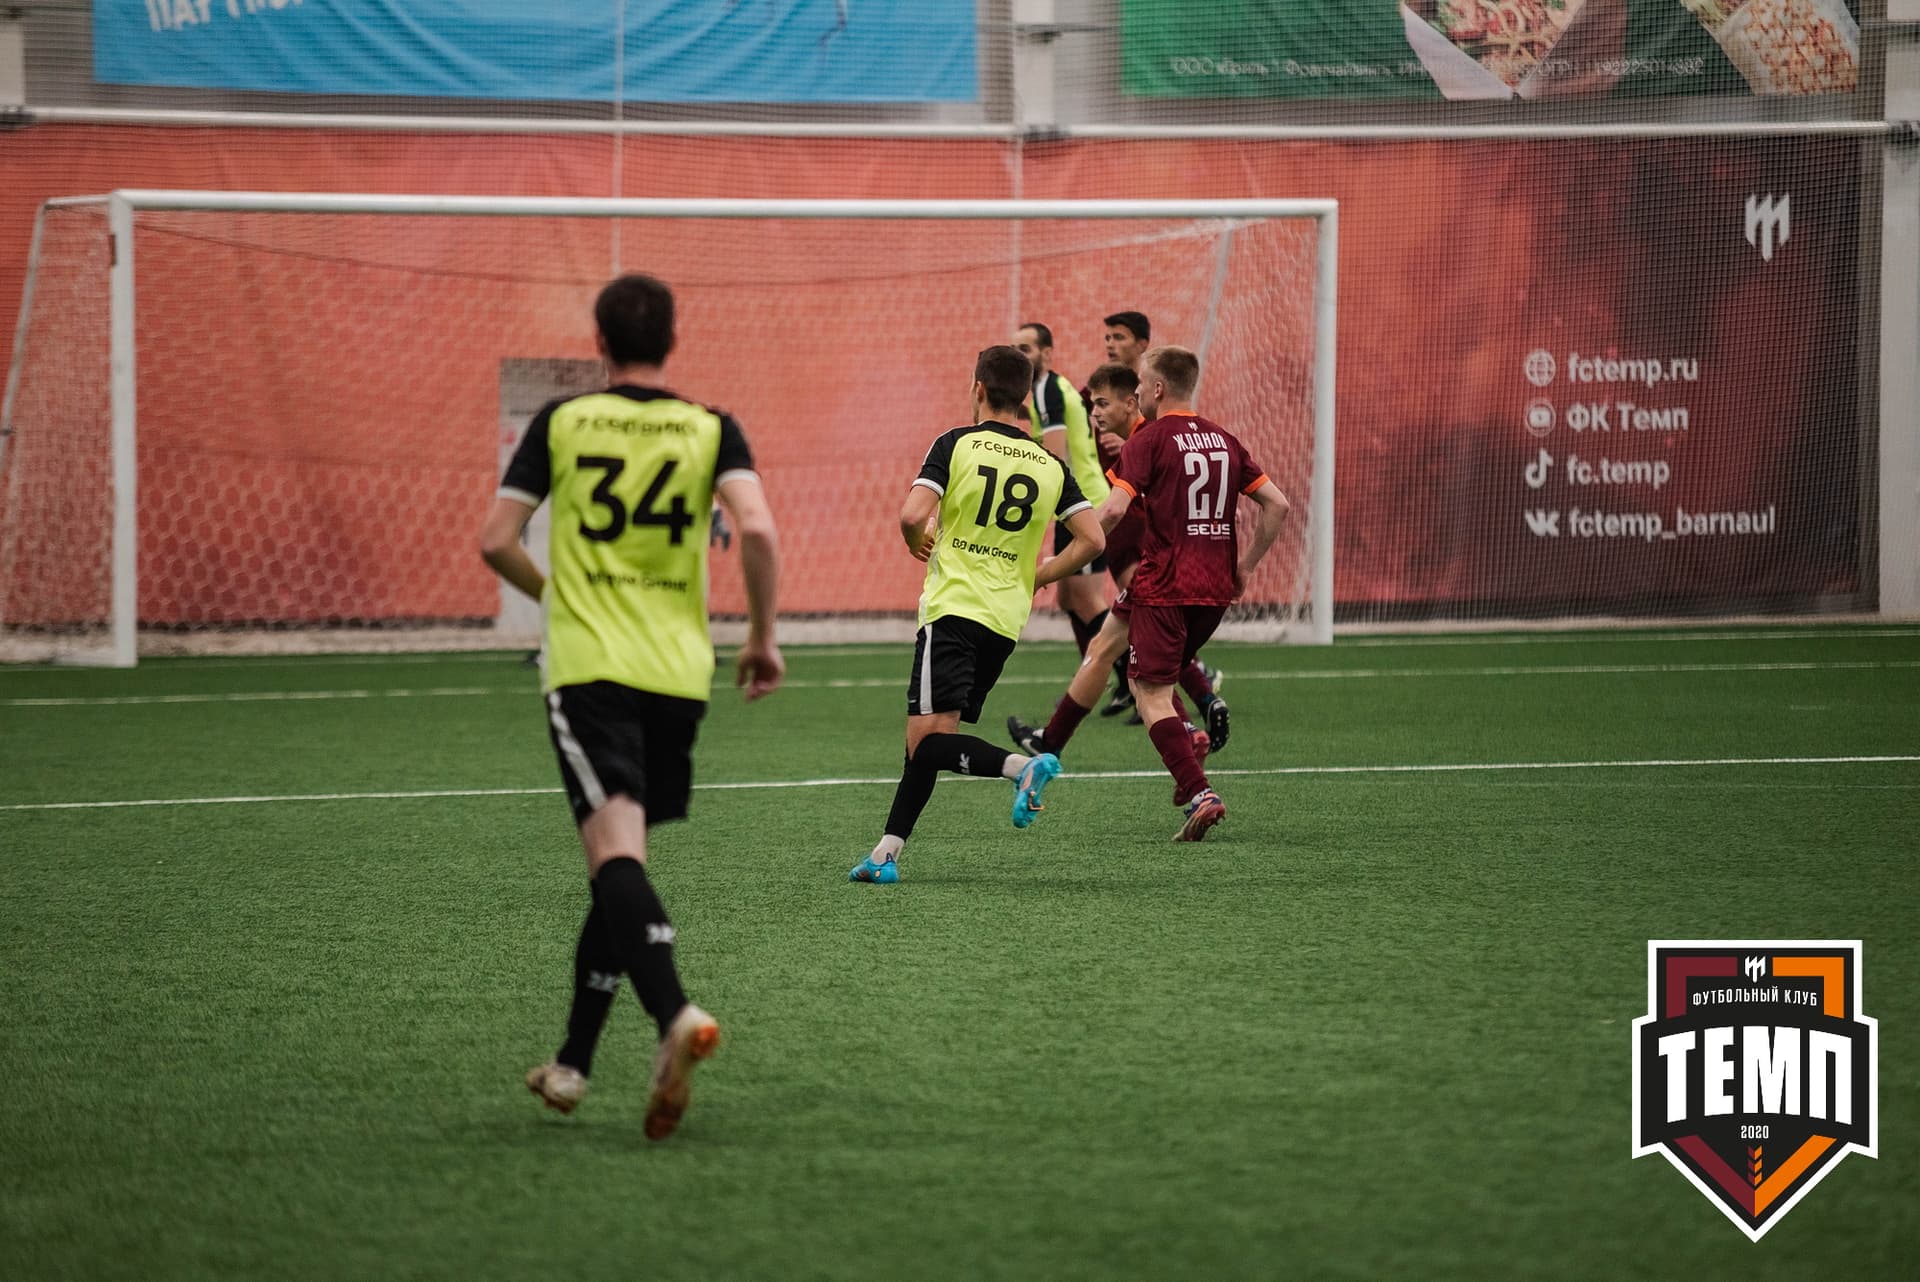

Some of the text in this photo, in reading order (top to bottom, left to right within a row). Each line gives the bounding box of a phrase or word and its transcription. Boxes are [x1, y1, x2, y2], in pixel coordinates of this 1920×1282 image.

[1568, 352, 1698, 388] fctemp.ru
[1567, 401, 1689, 432] ФК Темп
[983, 441, 1048, 465] сервико
[1184, 451, 1230, 520] 27
[1567, 454, 1670, 489] fc.temp
[576, 455, 695, 547] 34
[975, 465, 1039, 532] 18
[1569, 506, 1776, 543] fctemp_barnaul
[968, 541, 1018, 562] RVM Group
